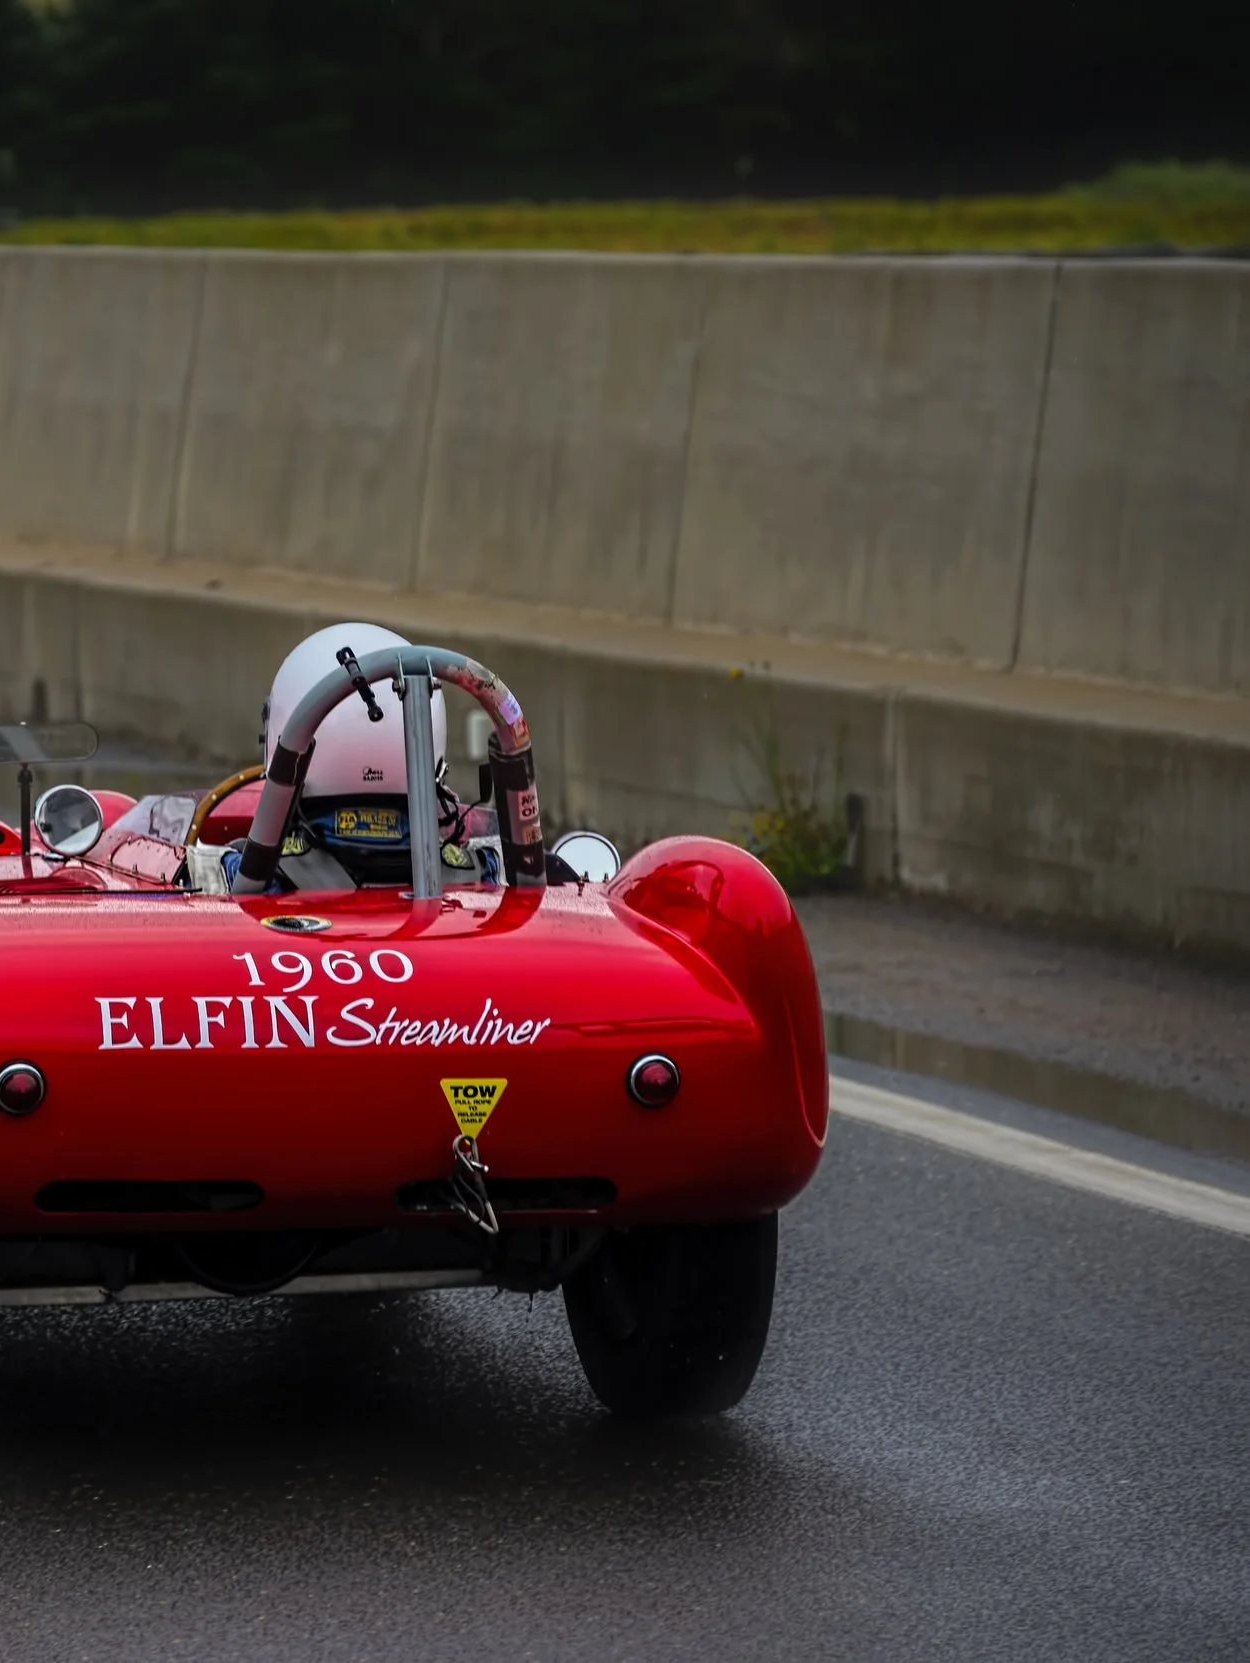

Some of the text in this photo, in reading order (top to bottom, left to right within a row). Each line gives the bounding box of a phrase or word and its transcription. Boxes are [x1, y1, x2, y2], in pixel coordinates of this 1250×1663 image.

[232, 949, 414, 993] 1960
[94, 995, 551, 1050] ELFIN Streamliner
[450, 1085, 497, 1098] TOW
